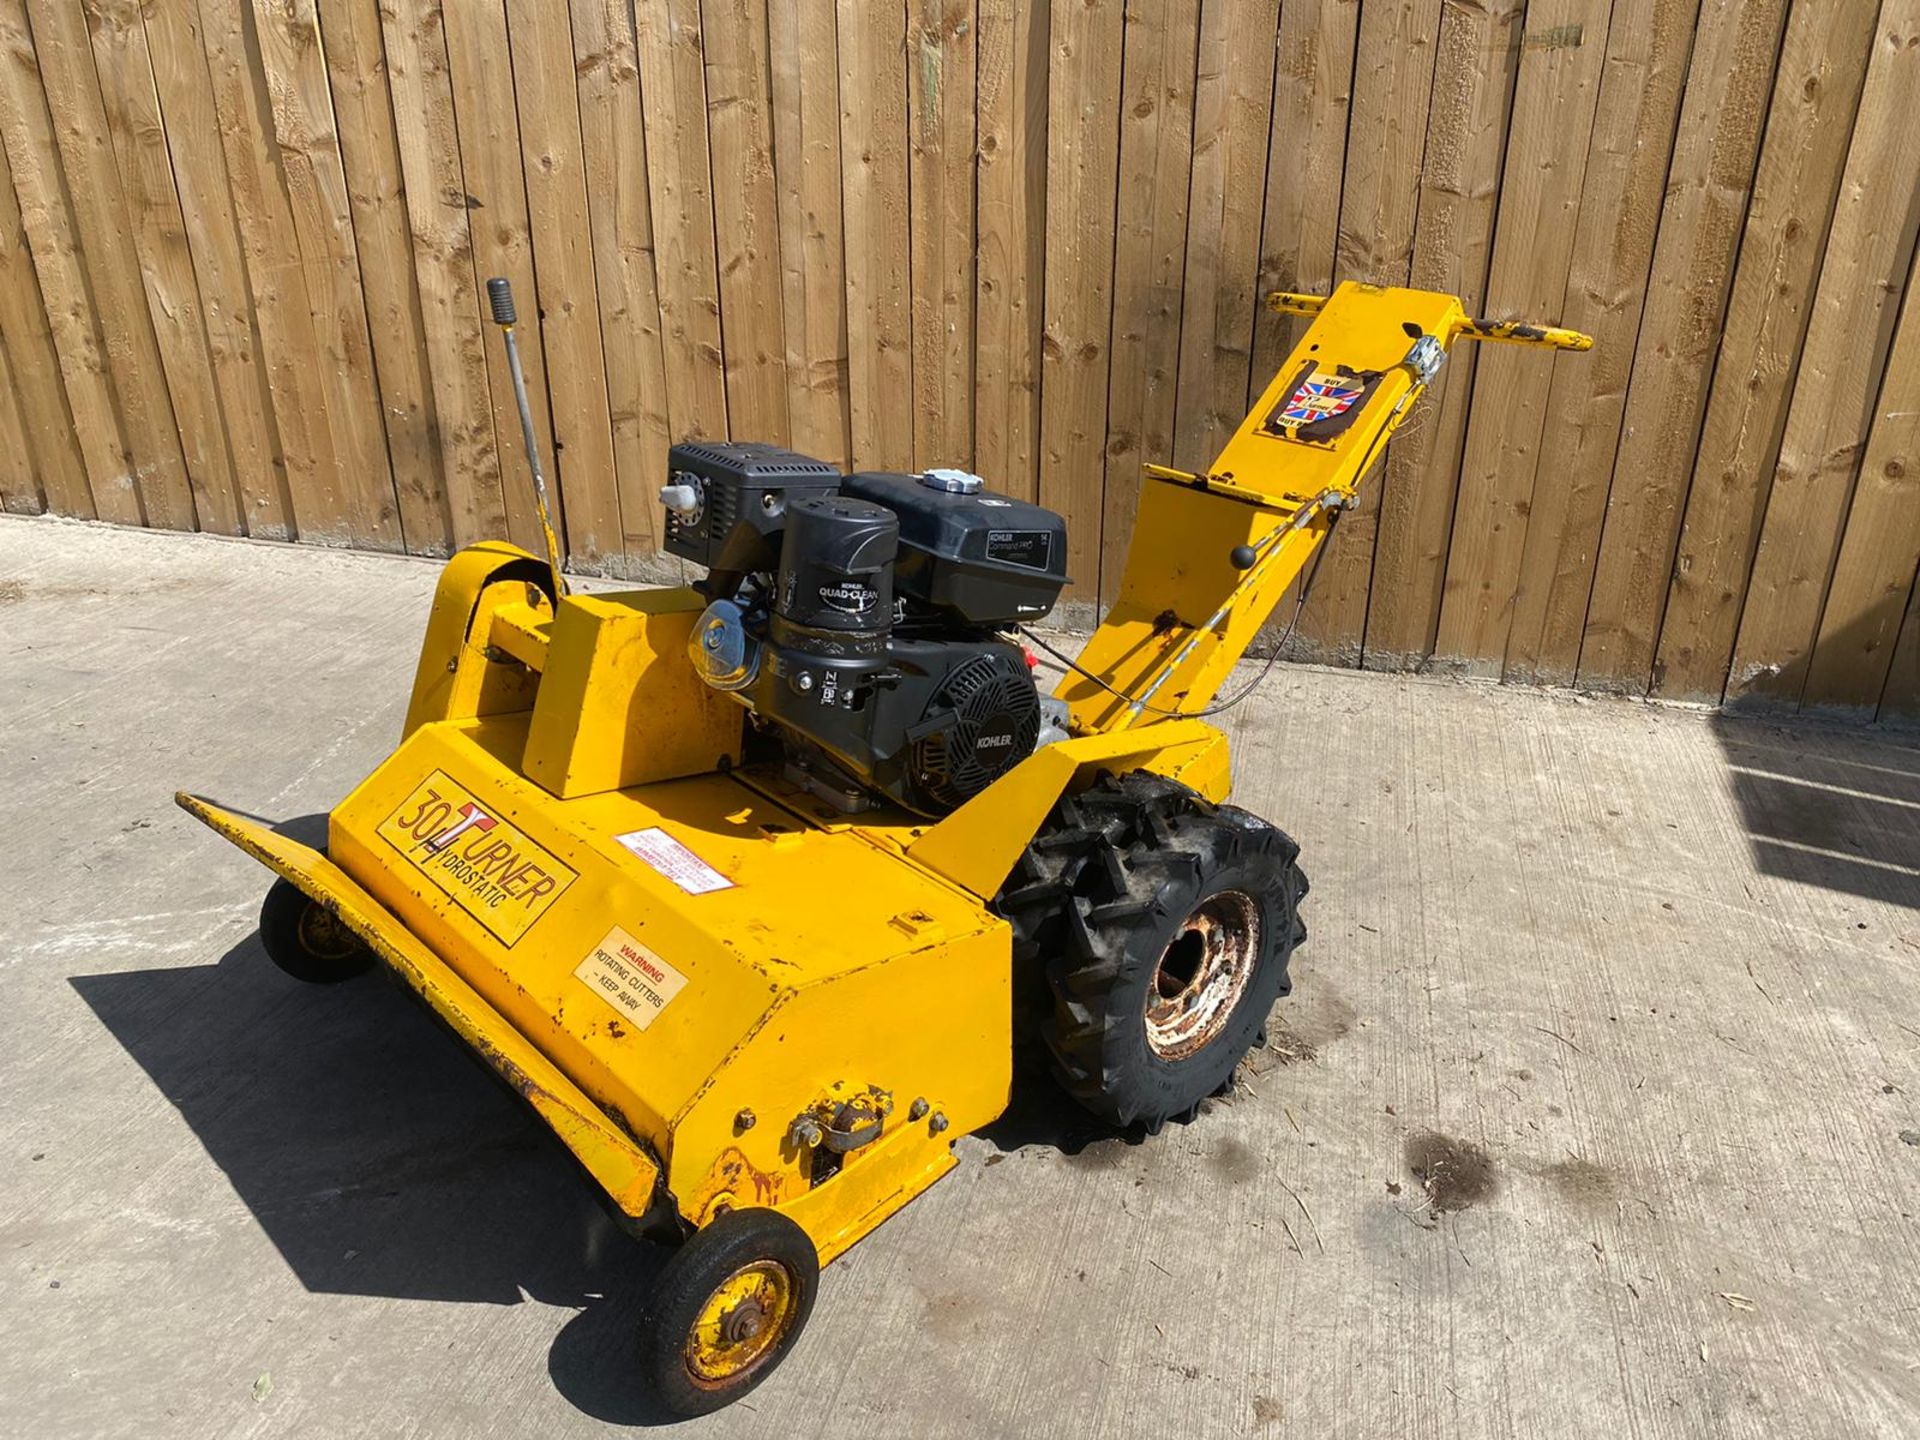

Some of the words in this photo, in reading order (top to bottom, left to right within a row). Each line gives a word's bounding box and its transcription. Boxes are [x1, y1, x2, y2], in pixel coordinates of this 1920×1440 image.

[1324, 378, 1341, 387] BUY
[976, 734, 1012, 749] KOHLER
[398, 788, 452, 841] 30
[409, 827, 507, 908] HYDROSTATIC
[424, 801, 556, 910] TURNER
[594, 948, 630, 981] ROTATING
[628, 976, 664, 1008] CUTTERS
[620, 944, 665, 983] WARNING
[598, 974, 620, 992] KEEP
[617, 991, 642, 1011] AWAY
